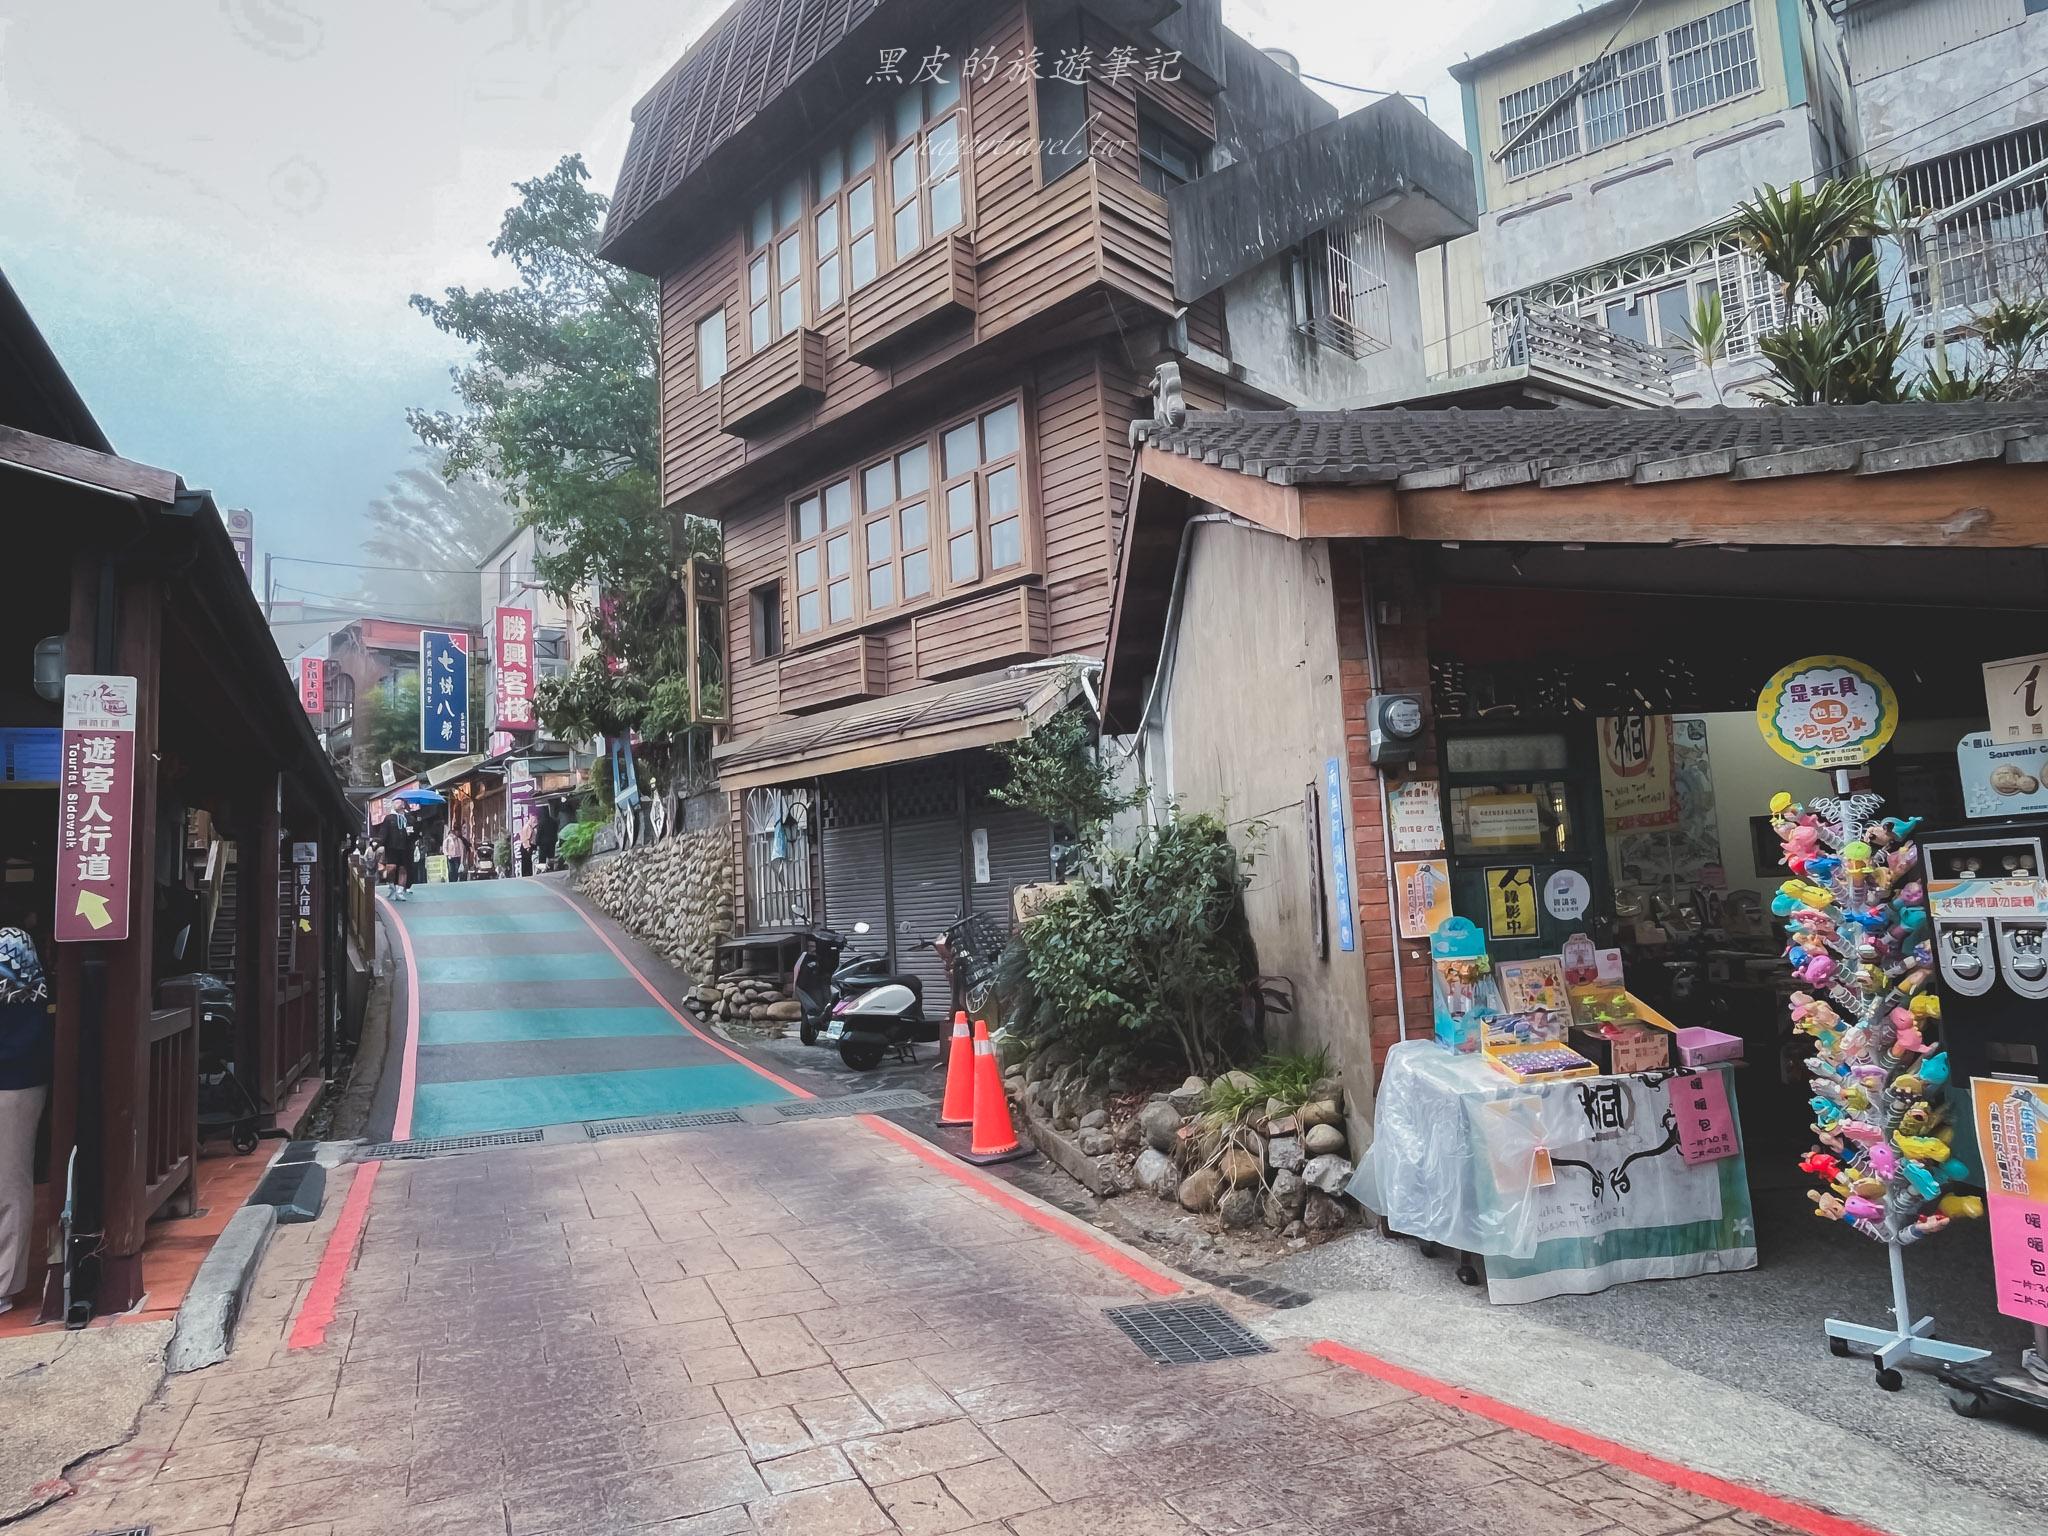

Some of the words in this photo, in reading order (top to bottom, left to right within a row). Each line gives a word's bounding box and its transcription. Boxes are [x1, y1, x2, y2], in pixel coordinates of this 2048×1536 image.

[502, 615, 528, 723] 勝興客棧
[1790, 676, 1859, 704] 是玩具
[1794, 716, 1867, 745] 泡泡水
[68, 743, 80, 787] Tourist
[1989, 746, 2037, 760] Souvenir
[65, 793, 79, 849] Sidewalk
[77, 736, 116, 881] 遊客人行道
[1504, 890, 1521, 934] 錄影中
[2025, 1213, 2046, 1276] 暖暖包
